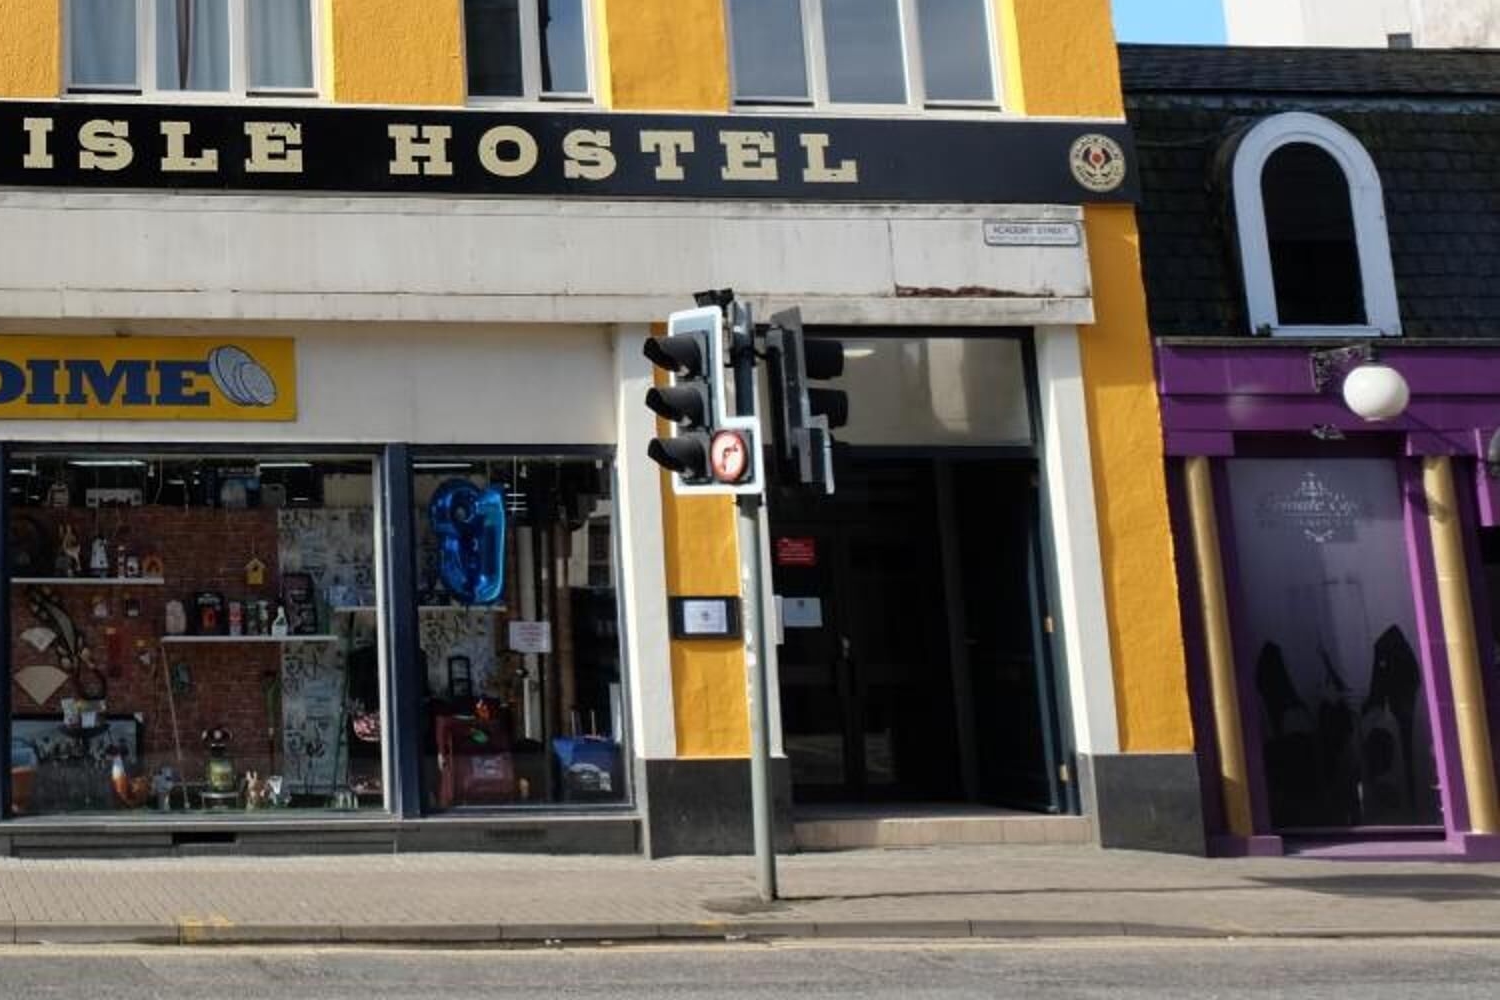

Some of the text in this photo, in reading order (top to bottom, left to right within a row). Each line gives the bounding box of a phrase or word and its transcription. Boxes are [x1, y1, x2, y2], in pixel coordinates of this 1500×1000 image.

[23, 117, 303, 172] ISLE
[388, 124, 859, 183] HOSTEL
[1037, 225, 1069, 235] STREET
